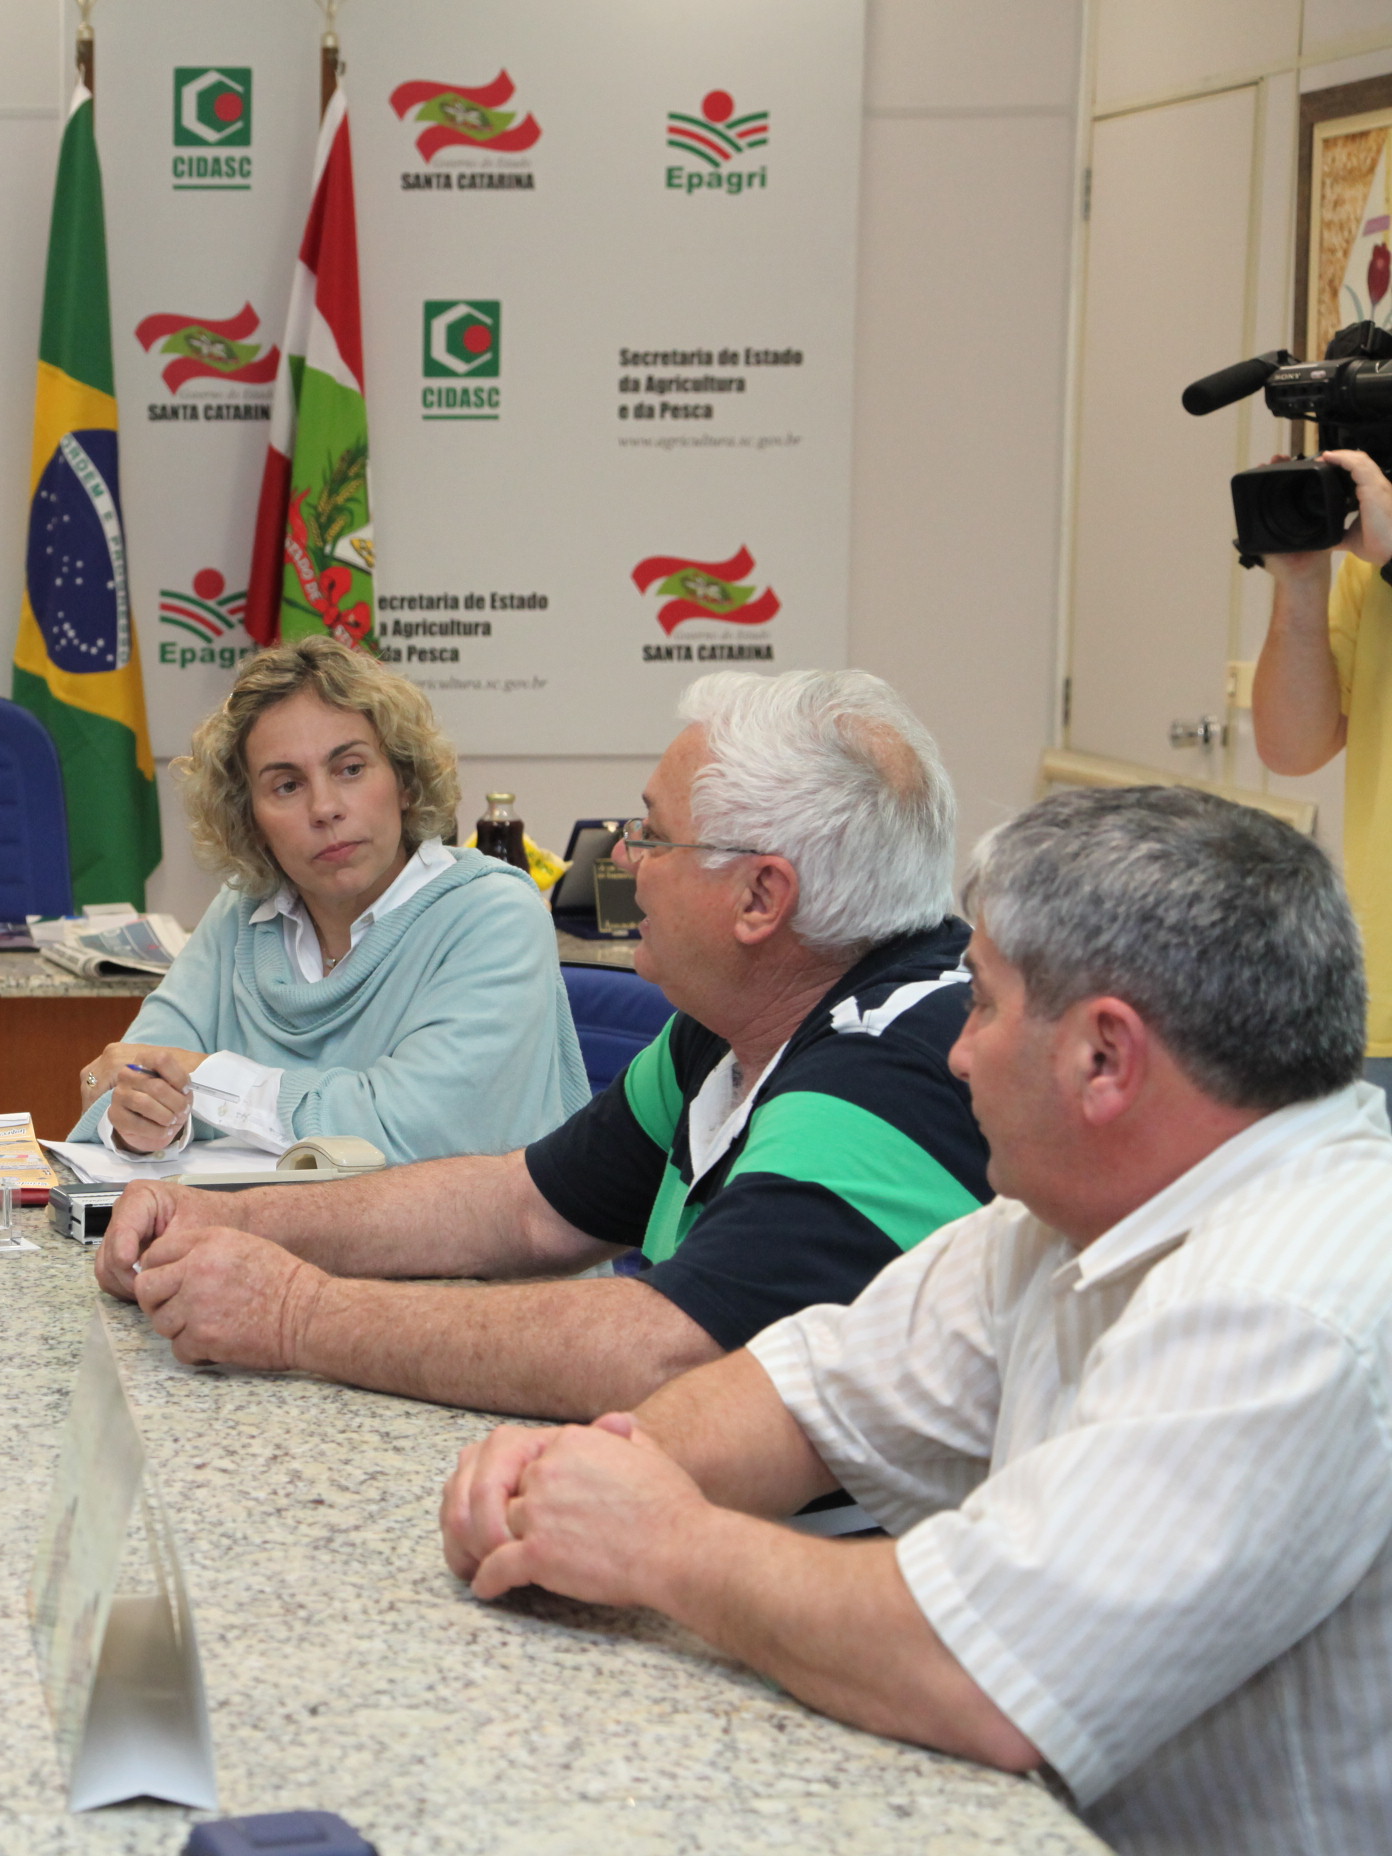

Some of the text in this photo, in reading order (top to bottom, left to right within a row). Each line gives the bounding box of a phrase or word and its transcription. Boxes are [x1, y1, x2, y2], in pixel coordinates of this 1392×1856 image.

[172, 155, 252, 179] CIDASC
[401, 172, 535, 190] SANTA CATARINA
[666, 165, 767, 195] Epagri
[619, 347, 804, 367] Secretaria de Estado
[618, 375, 746, 394] da Agricultura
[1274, 371, 1301, 380] SONY
[422, 386, 500, 409] CIDASC
[148, 403, 271, 421] SANTA CATARIN
[618, 401, 713, 420] e da Pesca
[378, 591, 549, 611] ecretaria de Estado
[392, 620, 491, 637] Agricultura
[407, 645, 460, 662] Pesca
[642, 644, 774, 661] SANTA CATARINA
